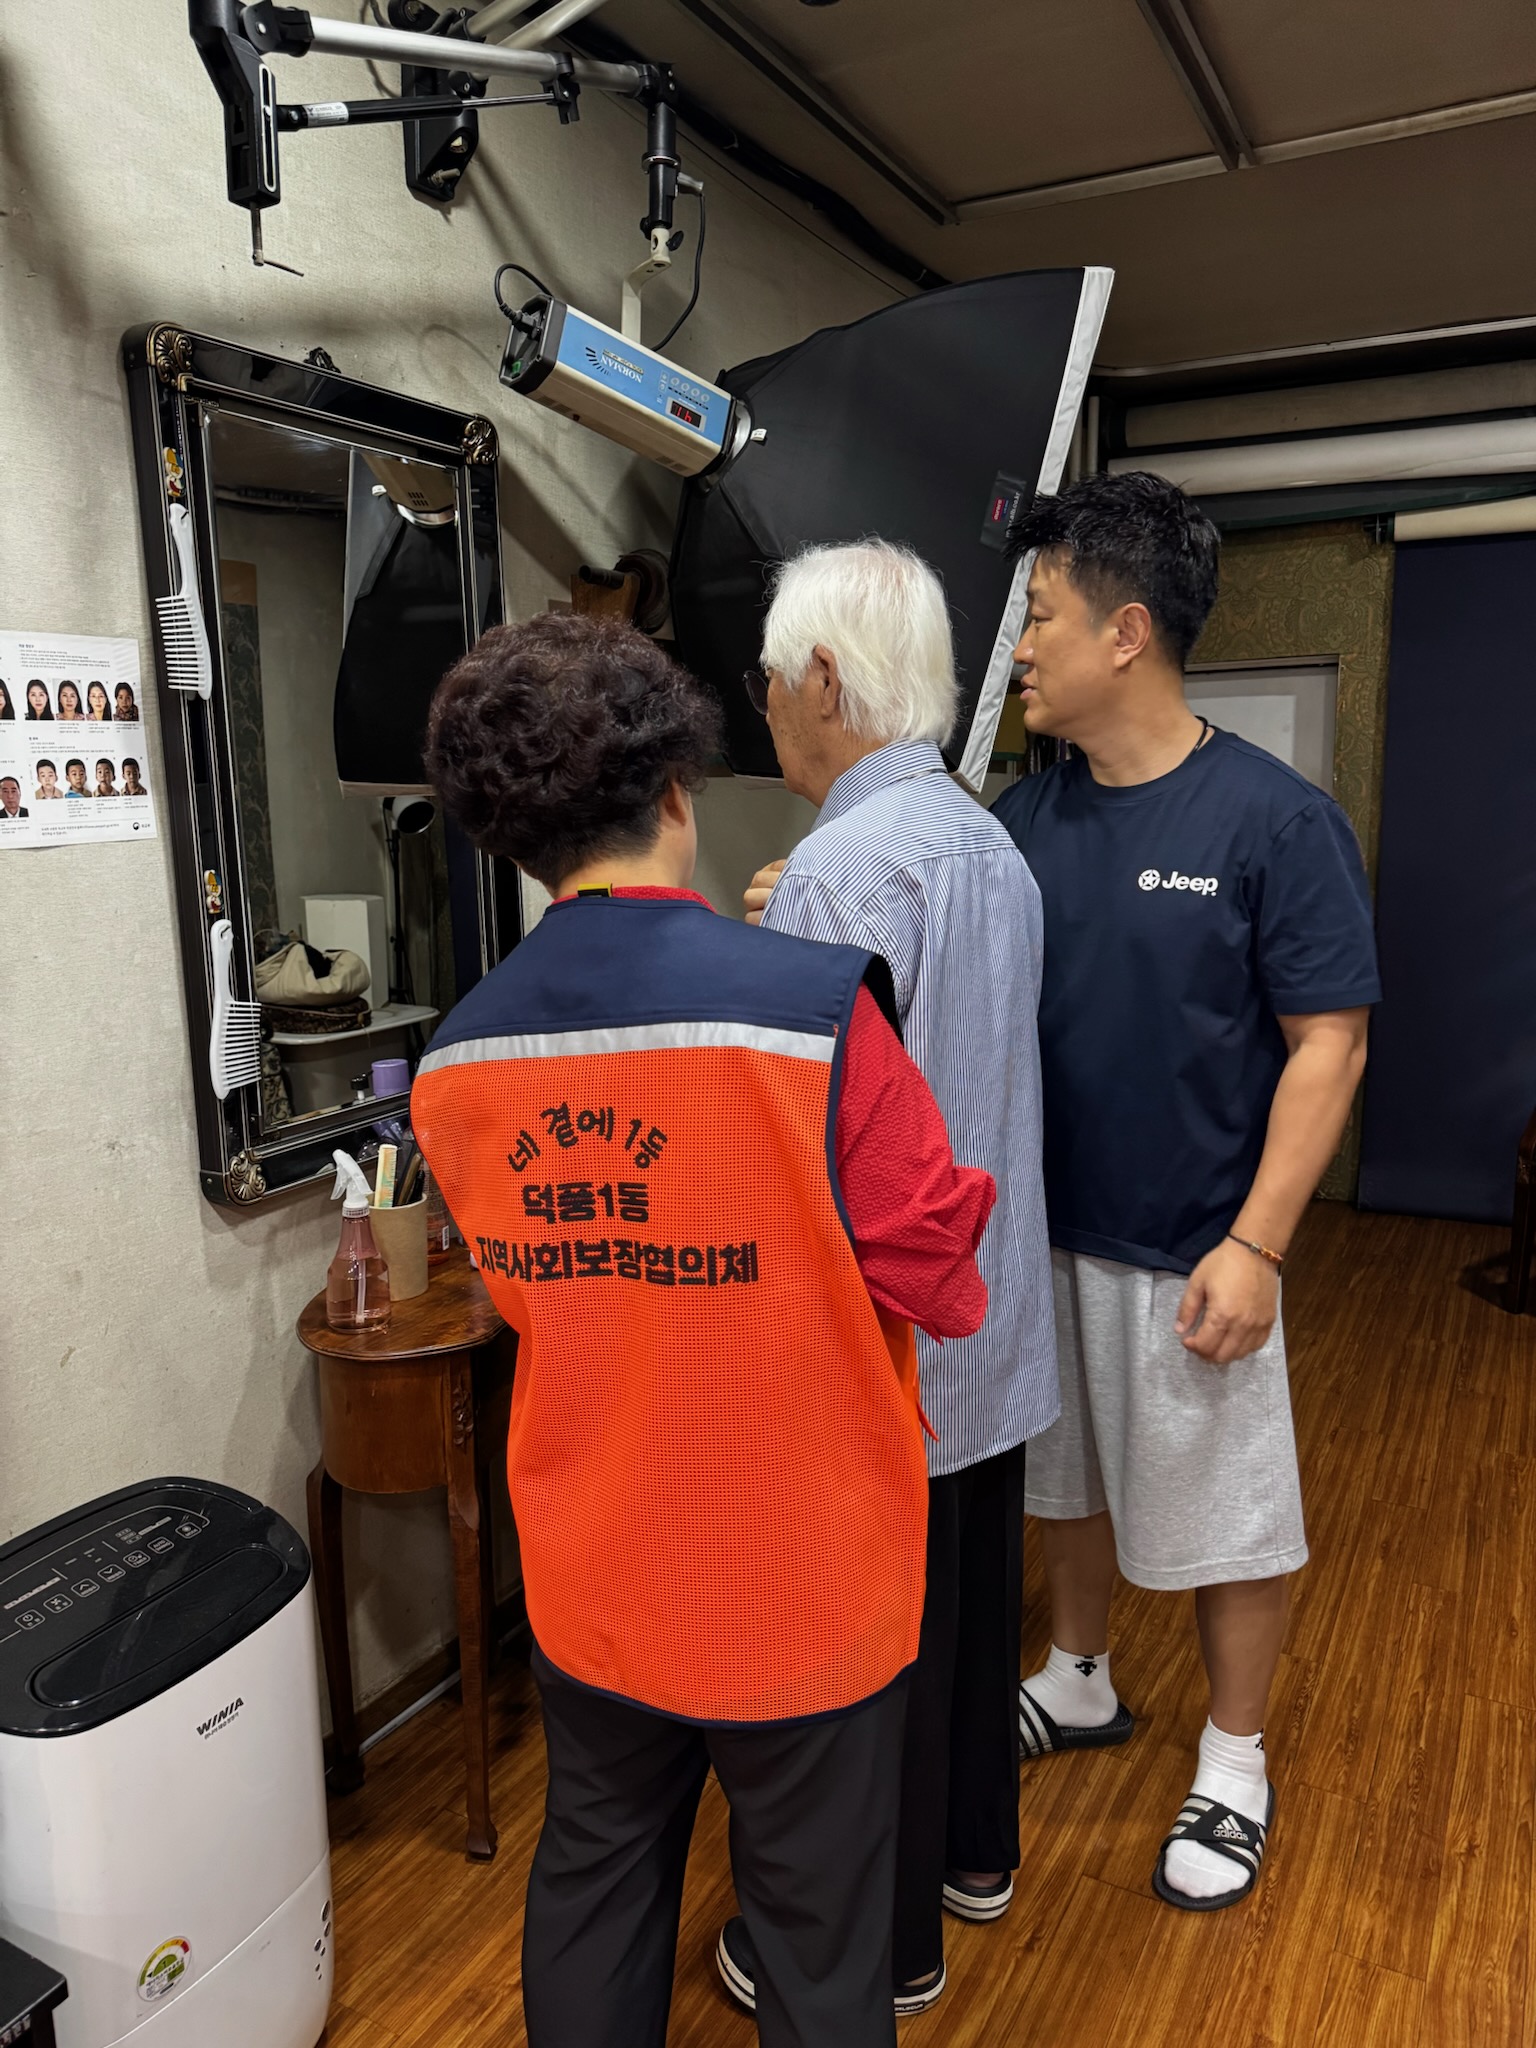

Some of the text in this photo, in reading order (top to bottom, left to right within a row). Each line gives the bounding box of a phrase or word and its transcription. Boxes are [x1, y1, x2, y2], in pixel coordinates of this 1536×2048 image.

[600, 354, 643, 384] NORMAN
[1162, 870, 1219, 897] Jeep
[507, 1129, 541, 1172] 네
[540, 1101, 614, 1149] 곁에
[522, 1182, 649, 1224] 덕풍1동
[475, 1235, 759, 1285] 지역사회보장협의체
[196, 1697, 244, 1736] WINIA
[1212, 1827, 1249, 1842] adidas
